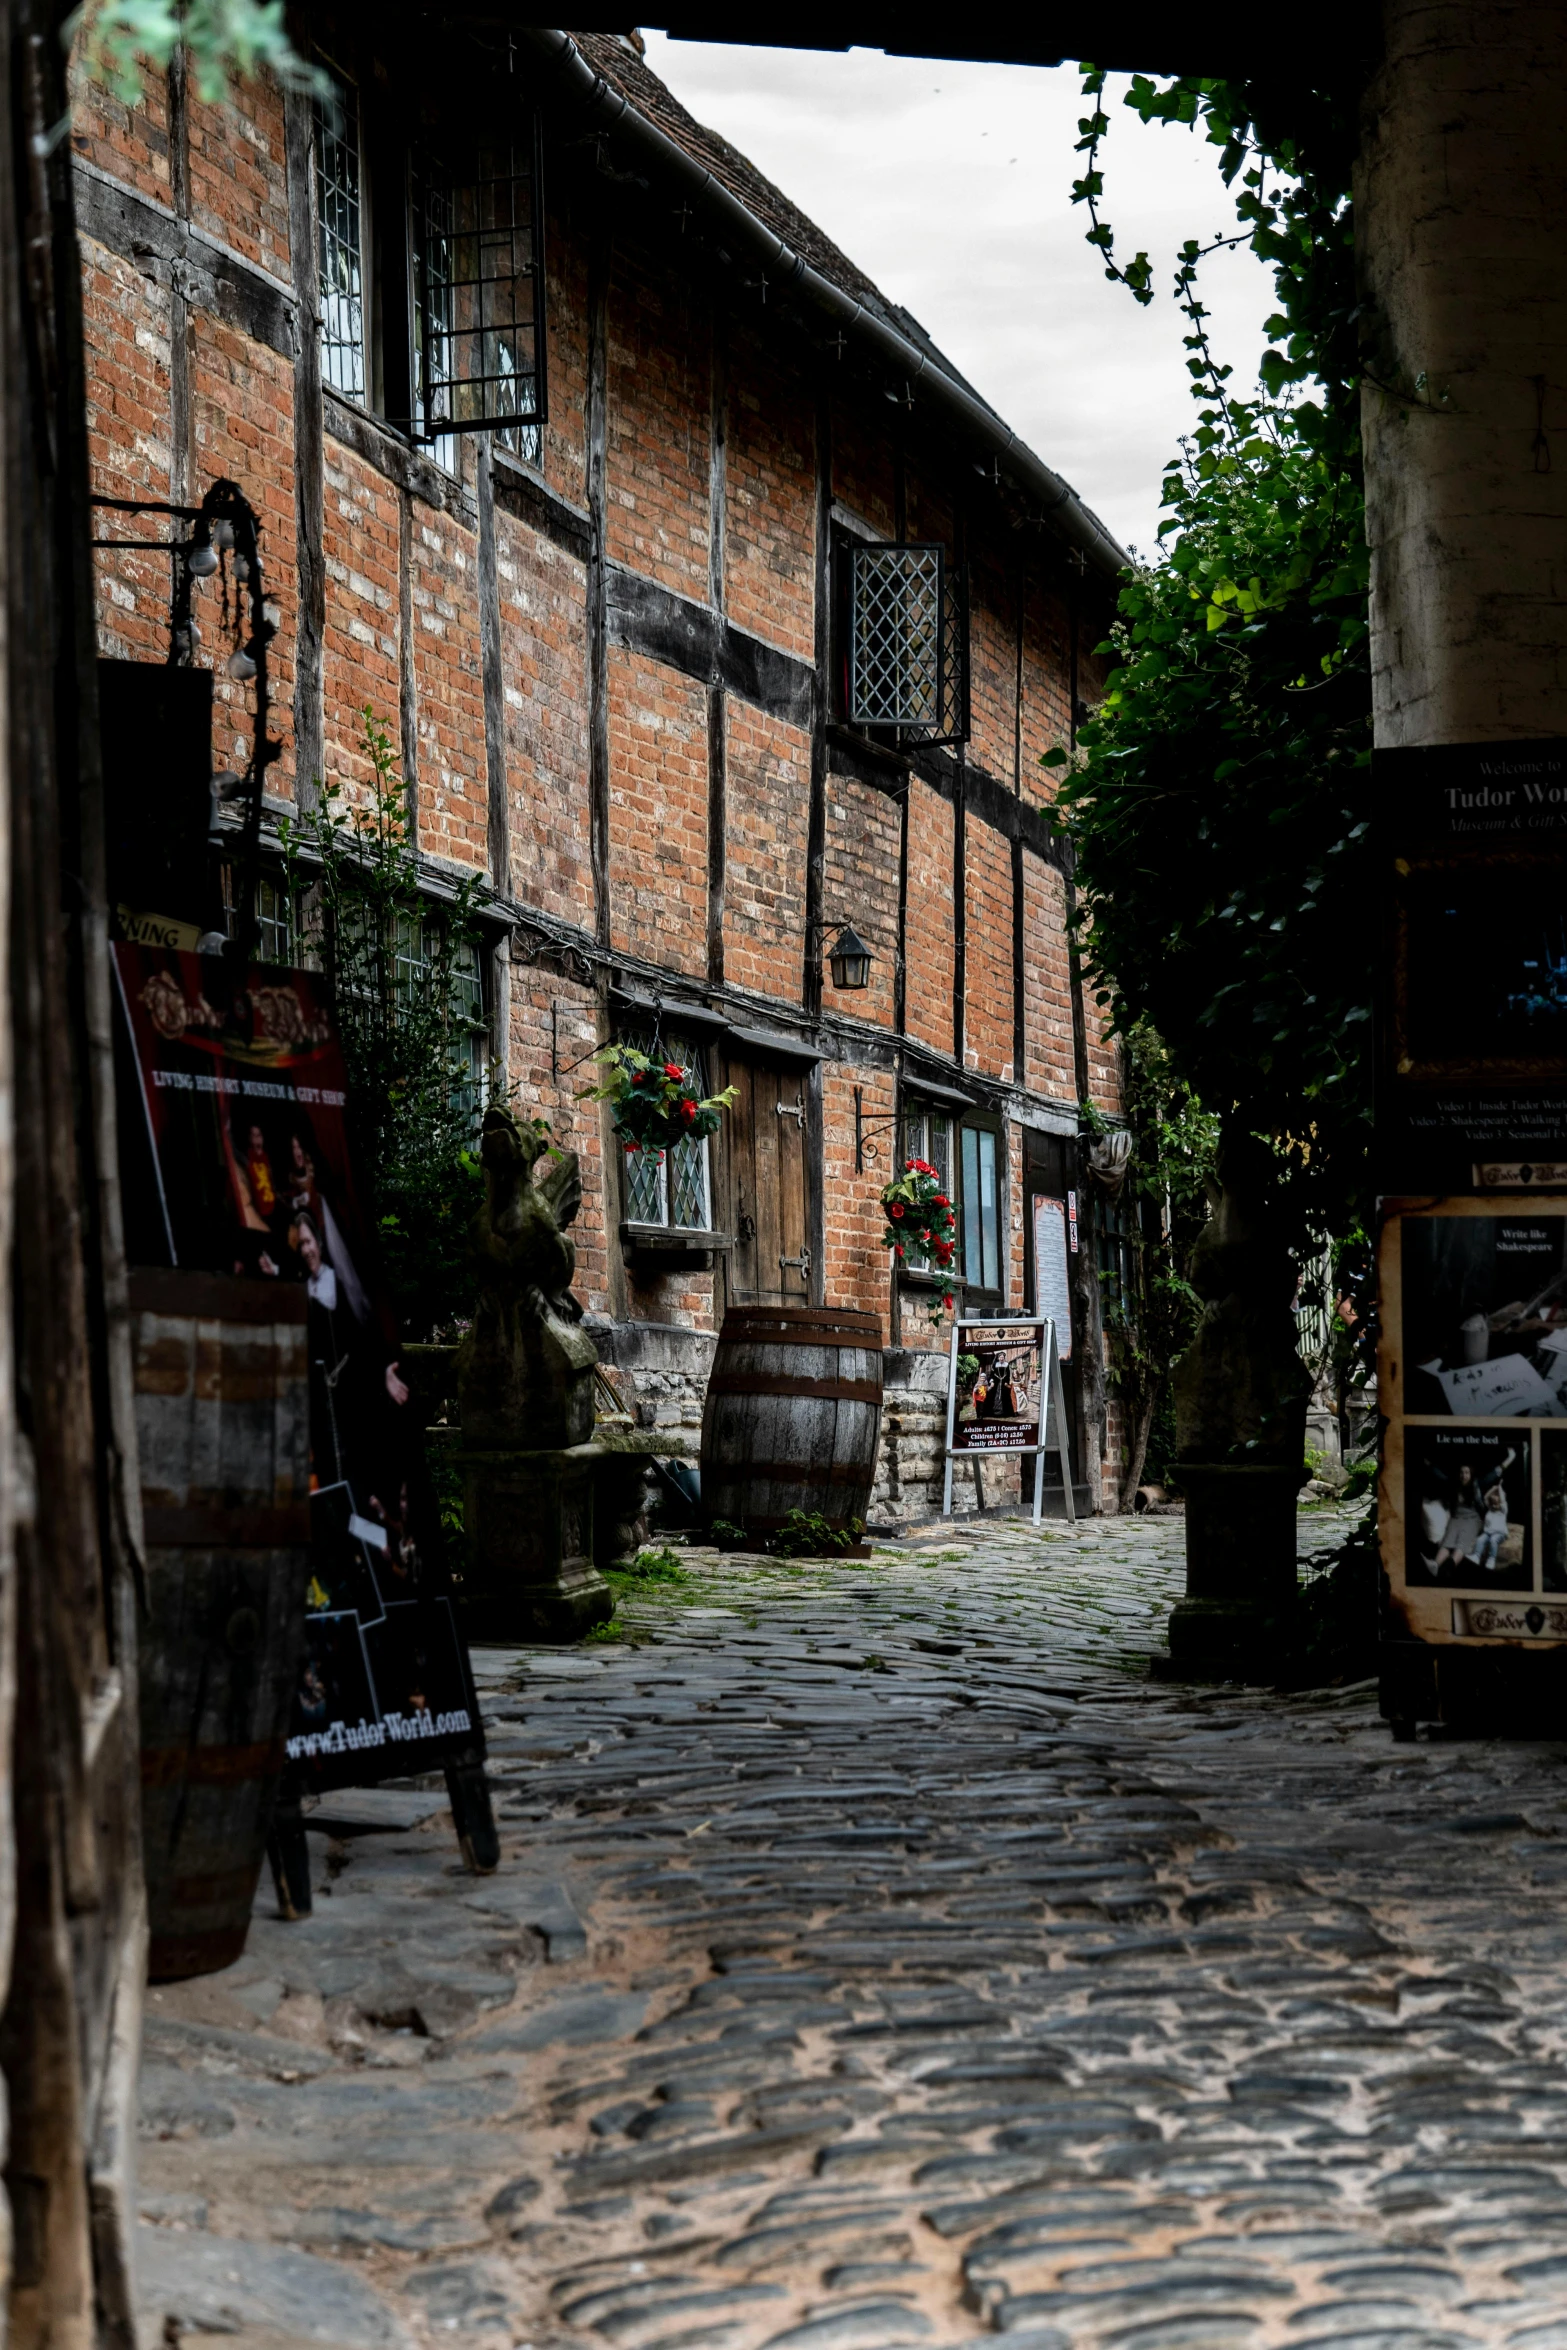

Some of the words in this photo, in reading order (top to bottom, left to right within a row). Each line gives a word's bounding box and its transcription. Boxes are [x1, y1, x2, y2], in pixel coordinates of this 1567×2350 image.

[1480, 761, 1543, 775] Welcome
[1548, 761, 1561, 772] to
[1444, 786, 1516, 808] Tudor
[1448, 818, 1506, 831] Museum
[1510, 815, 1522, 829] &
[1528, 813, 1555, 828] Gift
[152, 1070, 194, 1090] LIVING
[194, 1075, 240, 1094] HISTORY
[242, 1080, 287, 1099] MUSEUM
[296, 1086, 320, 1103] GIFT
[320, 1089, 346, 1106] SHOP
[1436, 1101, 1465, 1111] Video
[1479, 1100, 1508, 1111] Inside
[1512, 1100, 1539, 1111] Tudor
[1408, 1116, 1437, 1126] Video
[1451, 1114, 1518, 1128] Shakespeare's
[1520, 1114, 1561, 1127] Walking
[1465, 1129, 1494, 1140] Video
[1508, 1129, 1551, 1140] Seasonal
[1502, 1229, 1528, 1239] Write
[1530, 1229, 1547, 1239] like
[1496, 1241, 1553, 1253] Shakespeare
[1436, 1433, 1451, 1443] Lie
[1466, 1434, 1480, 1444] the
[1482, 1434, 1499, 1445] bed
[286, 1708, 472, 1759] www.TudorWorld.com
